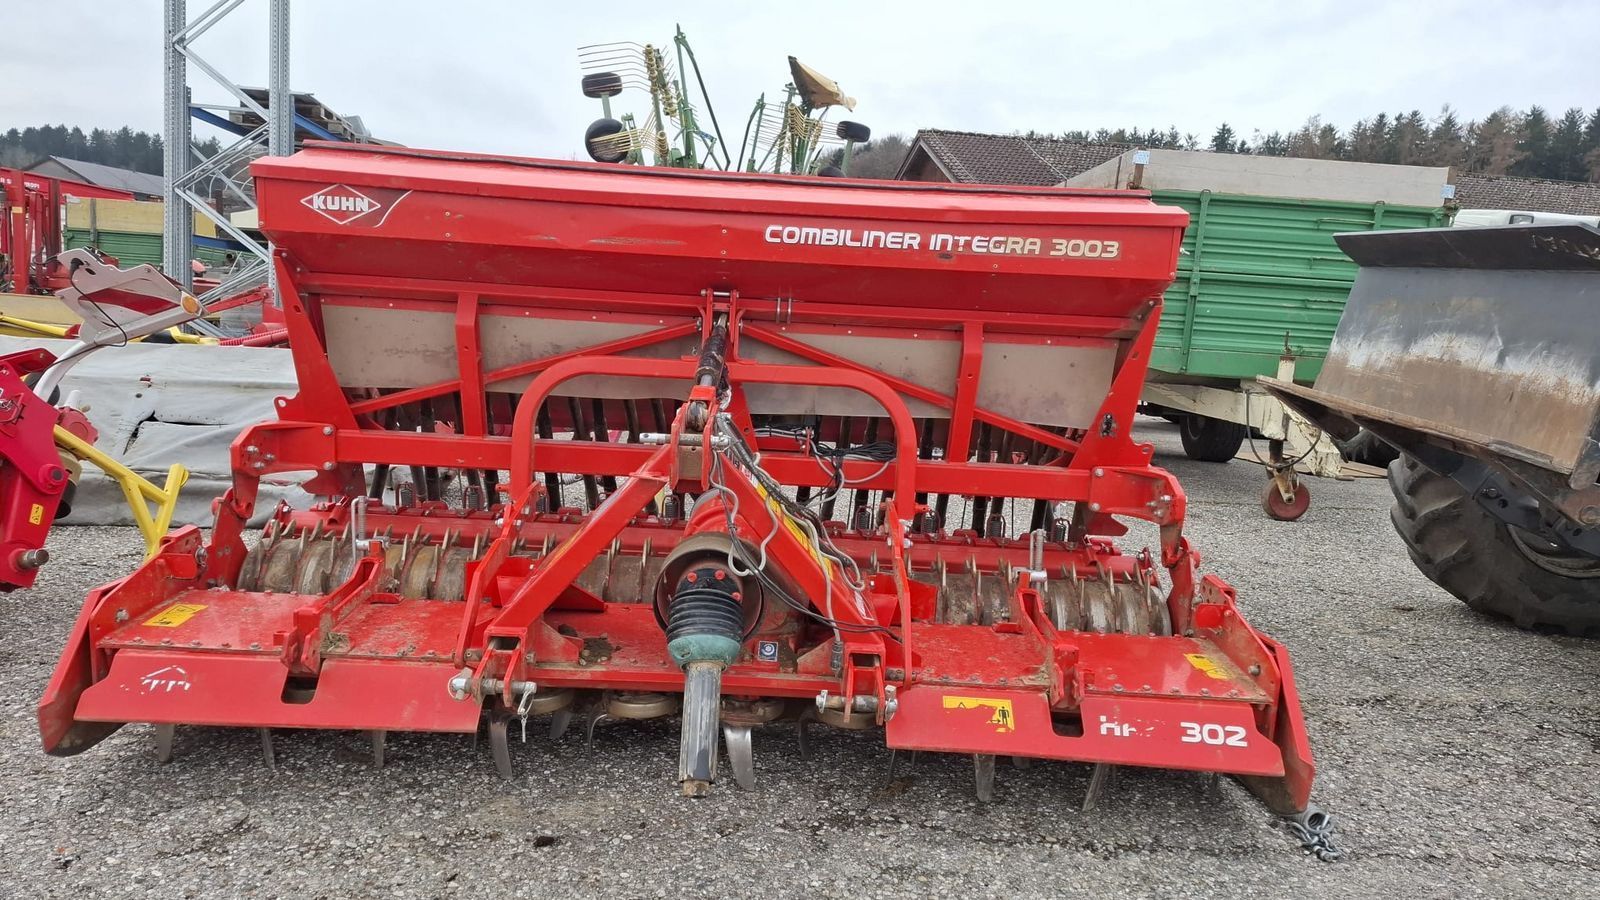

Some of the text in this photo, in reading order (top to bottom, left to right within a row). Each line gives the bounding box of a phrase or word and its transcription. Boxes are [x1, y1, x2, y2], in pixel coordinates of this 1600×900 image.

[312, 194, 369, 212] KUHN
[765, 224, 1119, 258] COMBILINER INTEGRA 3003
[1180, 721, 1248, 748] 302
